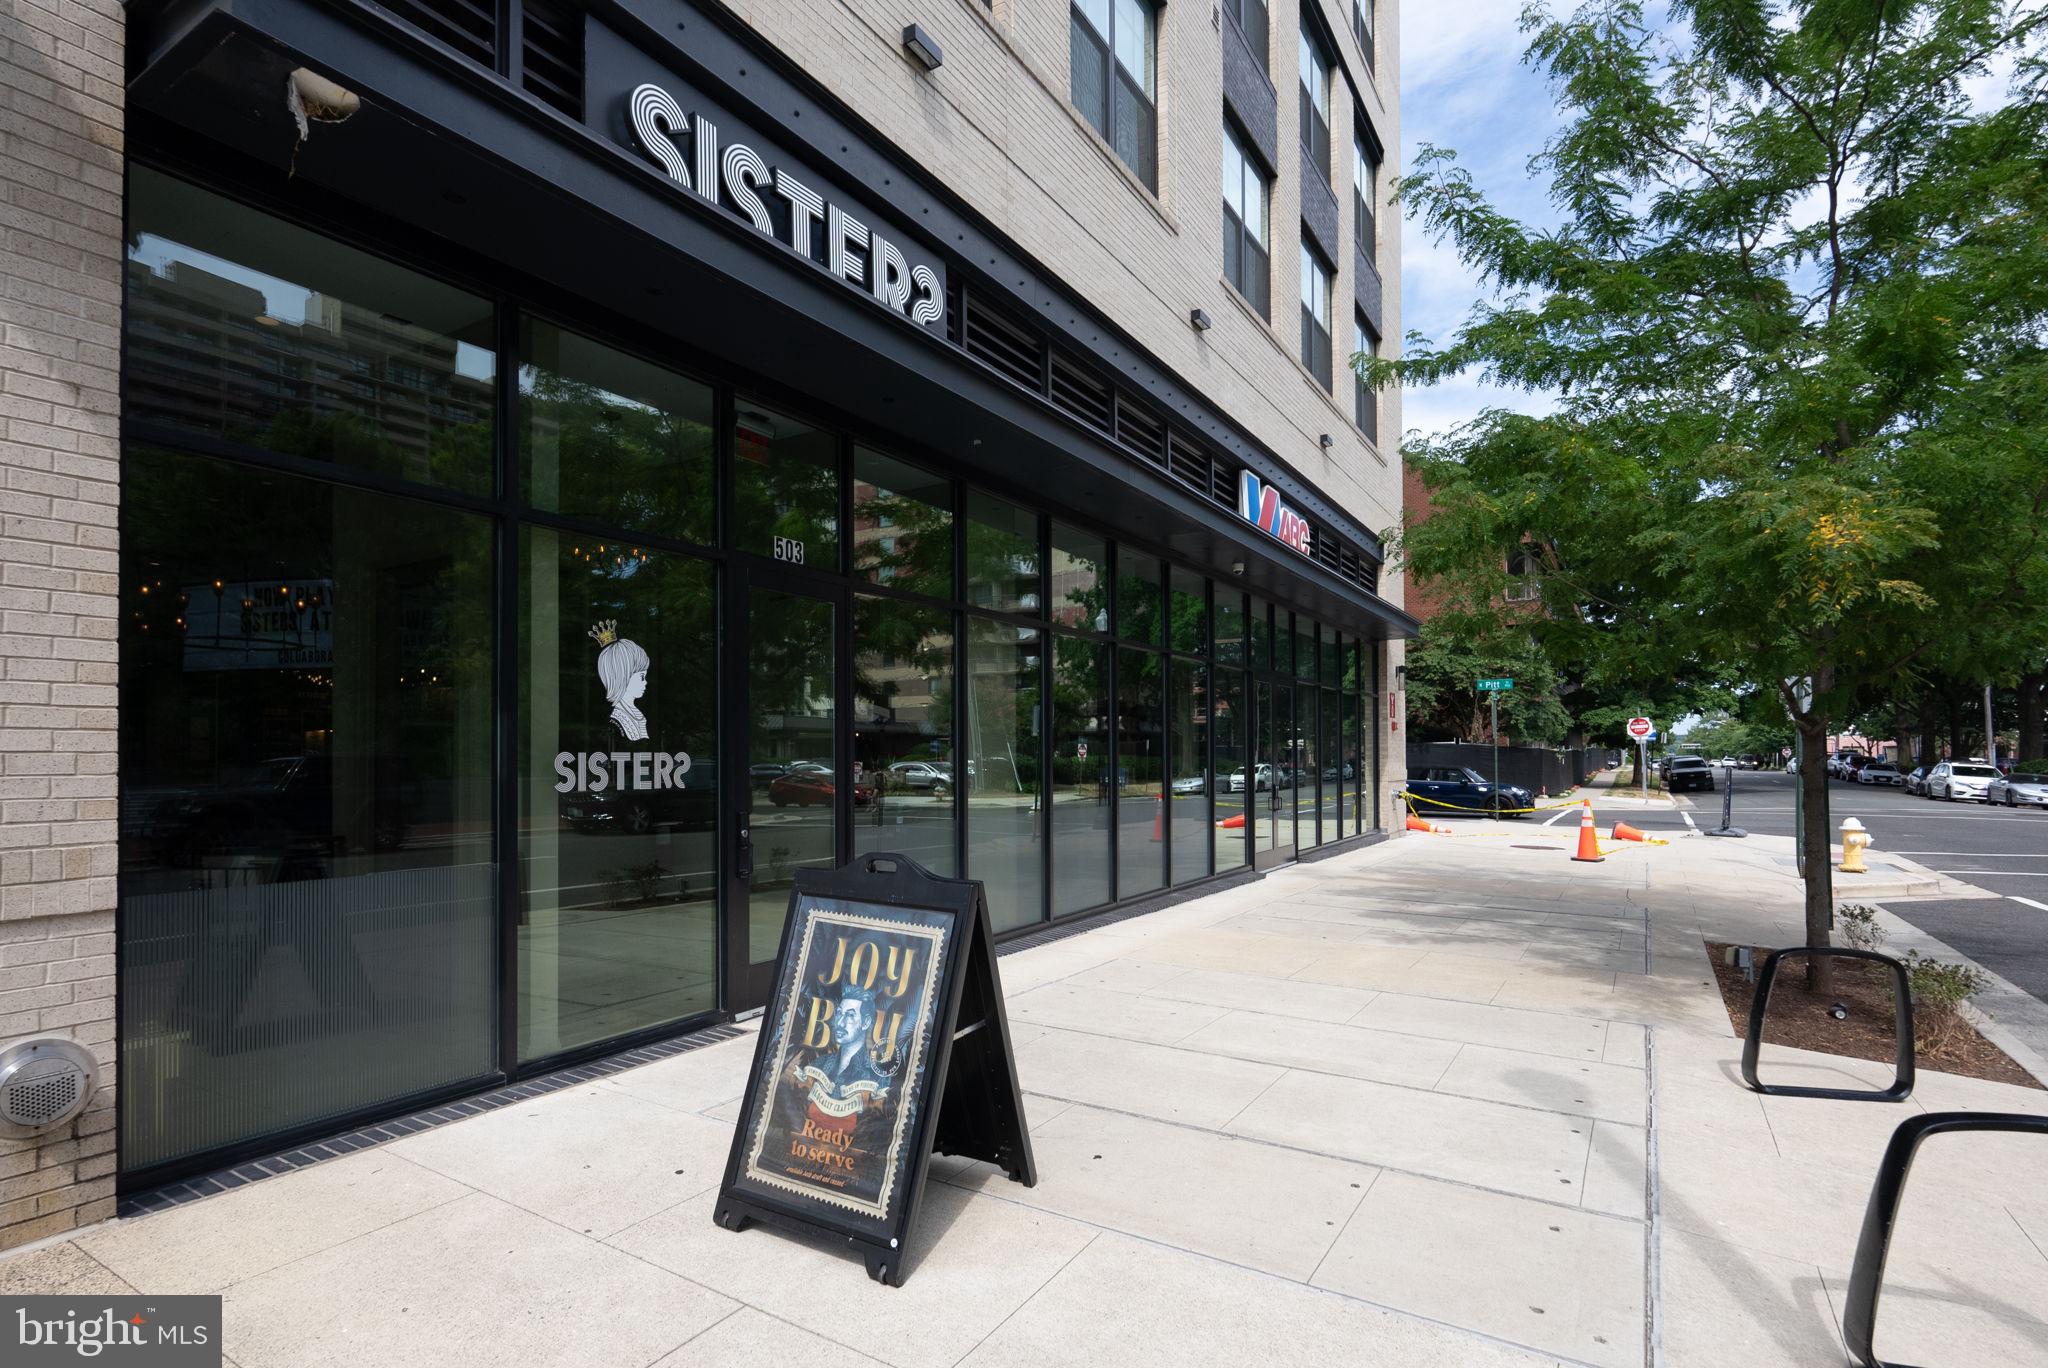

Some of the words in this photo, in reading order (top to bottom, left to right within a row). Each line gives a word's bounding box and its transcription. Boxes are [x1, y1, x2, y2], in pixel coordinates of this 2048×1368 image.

[631, 83, 944, 326] SISTERS
[775, 538, 803, 563] 503
[310, 611, 332, 631] AT
[1485, 681, 1500, 689] Pitt
[554, 751, 691, 792] SISTERS
[818, 938, 915, 998] JOY
[801, 1118, 854, 1152] Ready
[791, 1139, 807, 1157] to
[808, 1146, 856, 1171] serve
